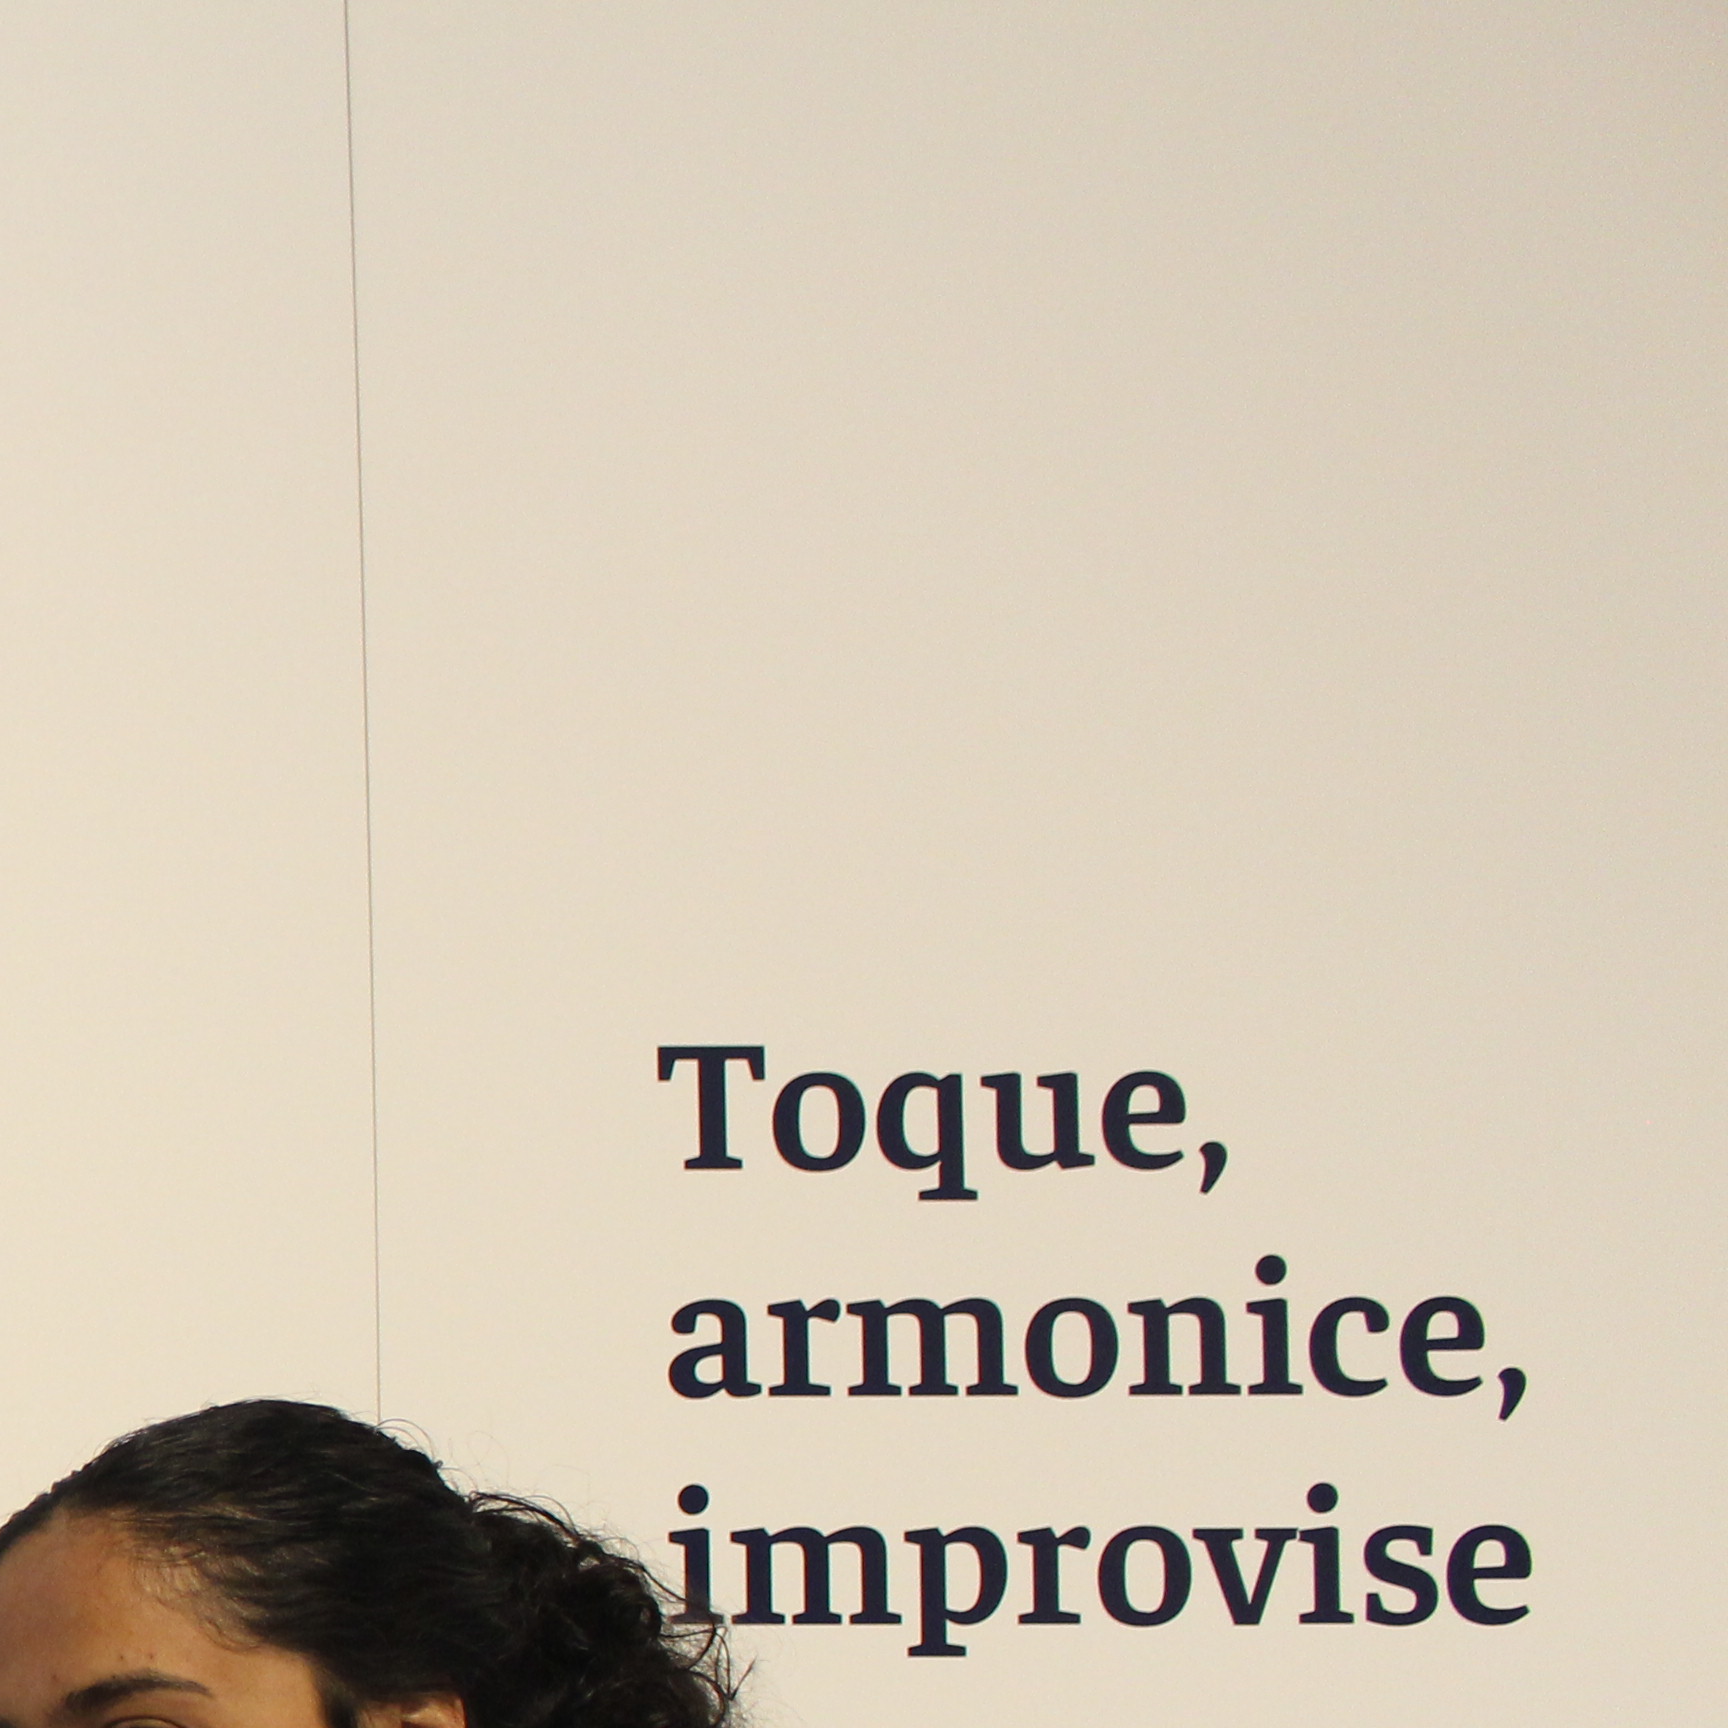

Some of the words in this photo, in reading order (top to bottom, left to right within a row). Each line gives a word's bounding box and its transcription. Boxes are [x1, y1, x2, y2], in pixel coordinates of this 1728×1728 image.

[656, 1044, 1229, 1202] Toque,
[667, 1253, 1527, 1422] armonice,
[668, 1481, 1535, 1660] improvise
